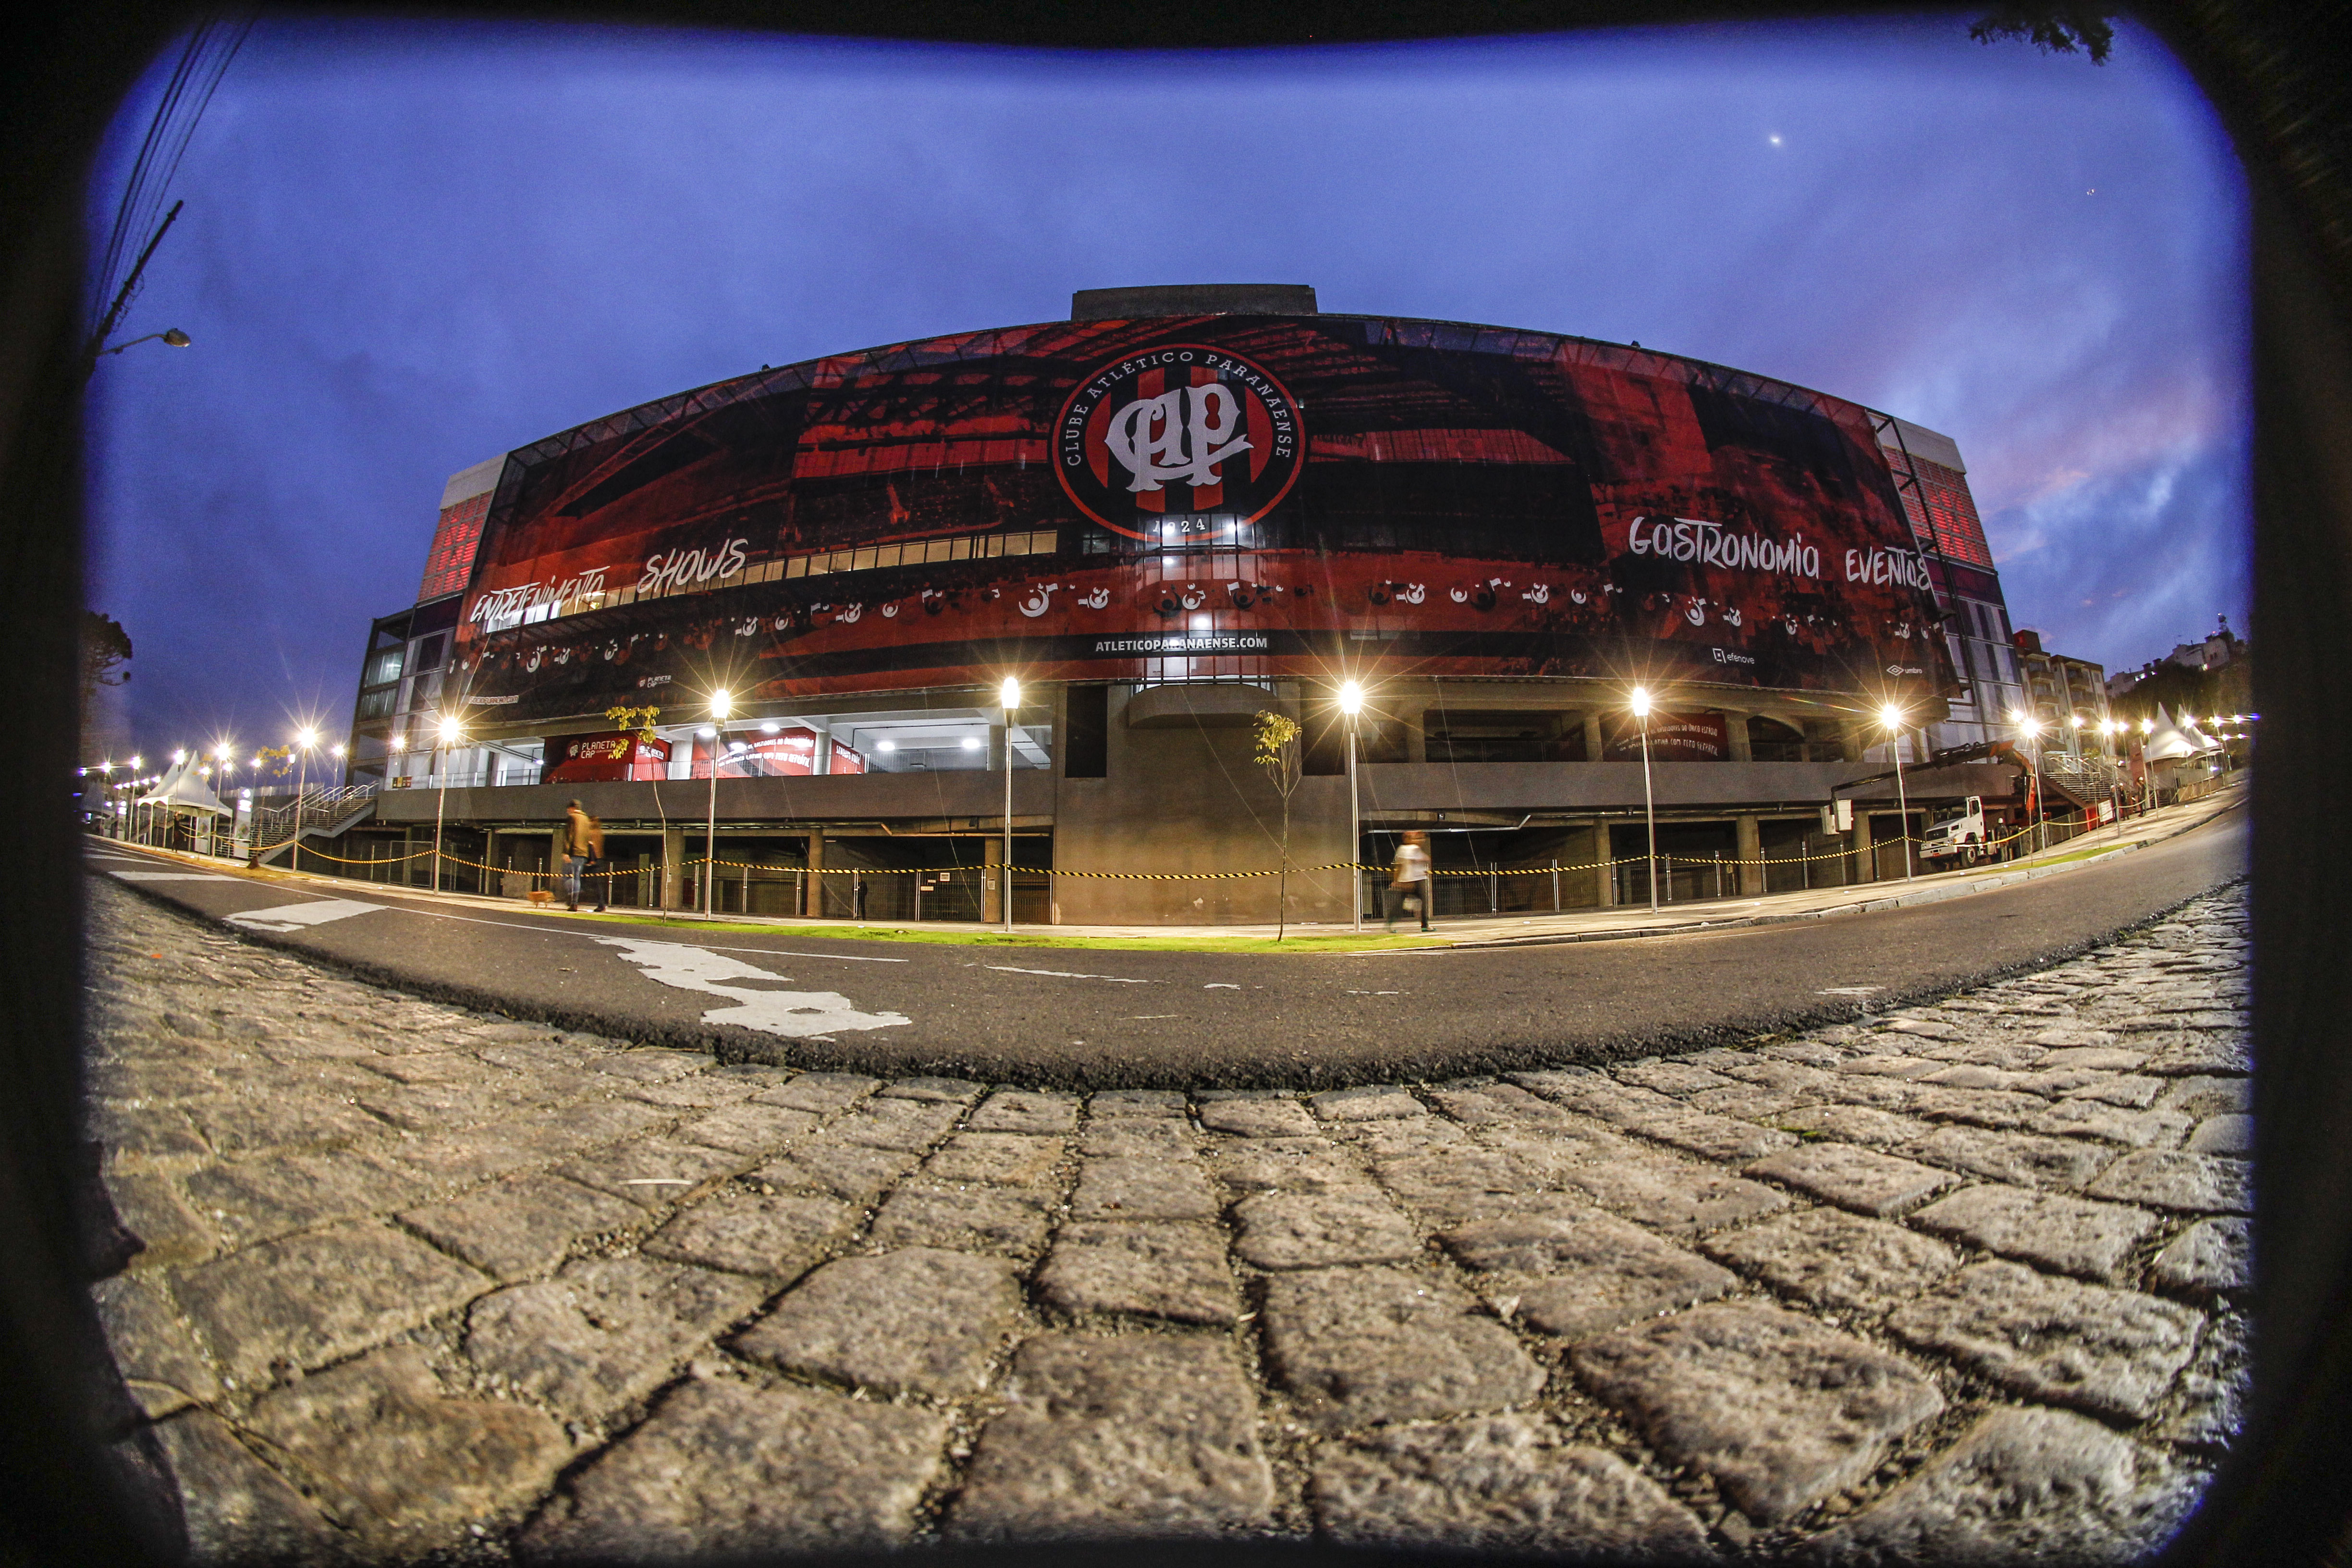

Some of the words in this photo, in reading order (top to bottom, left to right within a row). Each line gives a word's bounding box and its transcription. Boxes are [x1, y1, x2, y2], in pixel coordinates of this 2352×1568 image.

[1066, 404, 1088, 466] CLUBE
[1087, 352, 1194, 399] ATLÉTICO
[1205, 355, 1292, 458] PARANAENSE
[637, 538, 749, 594] SHOWS
[1846, 546, 1931, 590] EVENTOS
[1727, 653, 1755, 664] efenove
[581, 750, 596, 759] CAP
[582, 740, 616, 750] PLANETA
